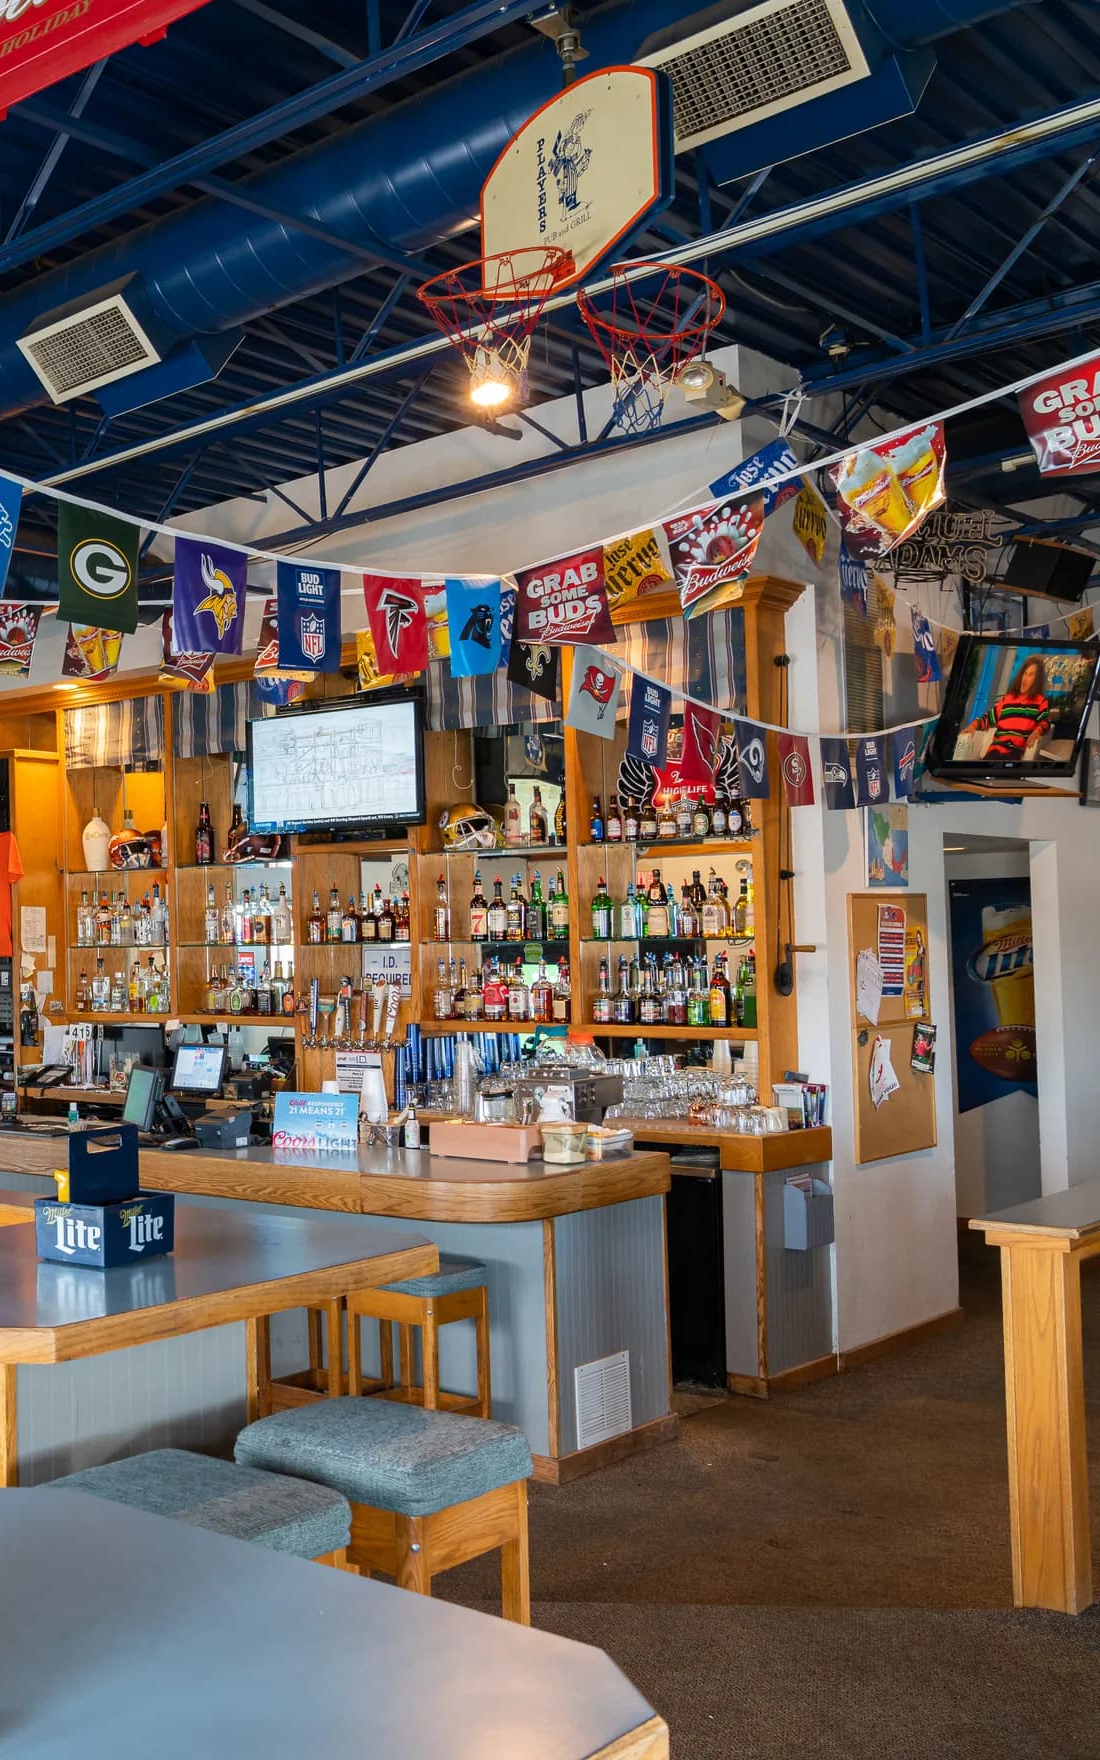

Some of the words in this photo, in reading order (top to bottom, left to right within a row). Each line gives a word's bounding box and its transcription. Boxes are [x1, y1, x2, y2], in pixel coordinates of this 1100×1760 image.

[536, 138, 548, 233] PLAYERS
[543, 231, 558, 247] PUB
[559, 224, 569, 238] and
[570, 212, 592, 230] GRILL
[1033, 371, 1100, 414] GR
[74, 544, 128, 595] G
[301, 572, 320, 585] BUD
[298, 583, 324, 596] LIGHT
[526, 562, 598, 599] GRAB
[540, 585, 588, 608] SOME
[528, 595, 602, 630] BUDS
[539, 616, 597, 637] Budweiser
[303, 634, 323, 655] NFL
[643, 735, 657, 753] NFL
[688, 785, 708, 794] LIFE
[471, 914, 483, 933] 7
[382, 955, 398, 969] I.D.
[366, 972, 411, 986] REQUIRE
[72, 1028, 78, 1038] 4
[79, 1028, 84, 1039] 1
[289, 1107, 297, 1115] 21
[300, 1107, 333, 1115] MEANS
[335, 1108, 346, 1116] 21
[273, 1130, 316, 1148] Coors
[318, 1138, 357, 1150] LIGHT
[43, 1206, 73, 1225] Miller
[54, 1215, 101, 1255] Lite
[128, 1214, 164, 1252] Lite
